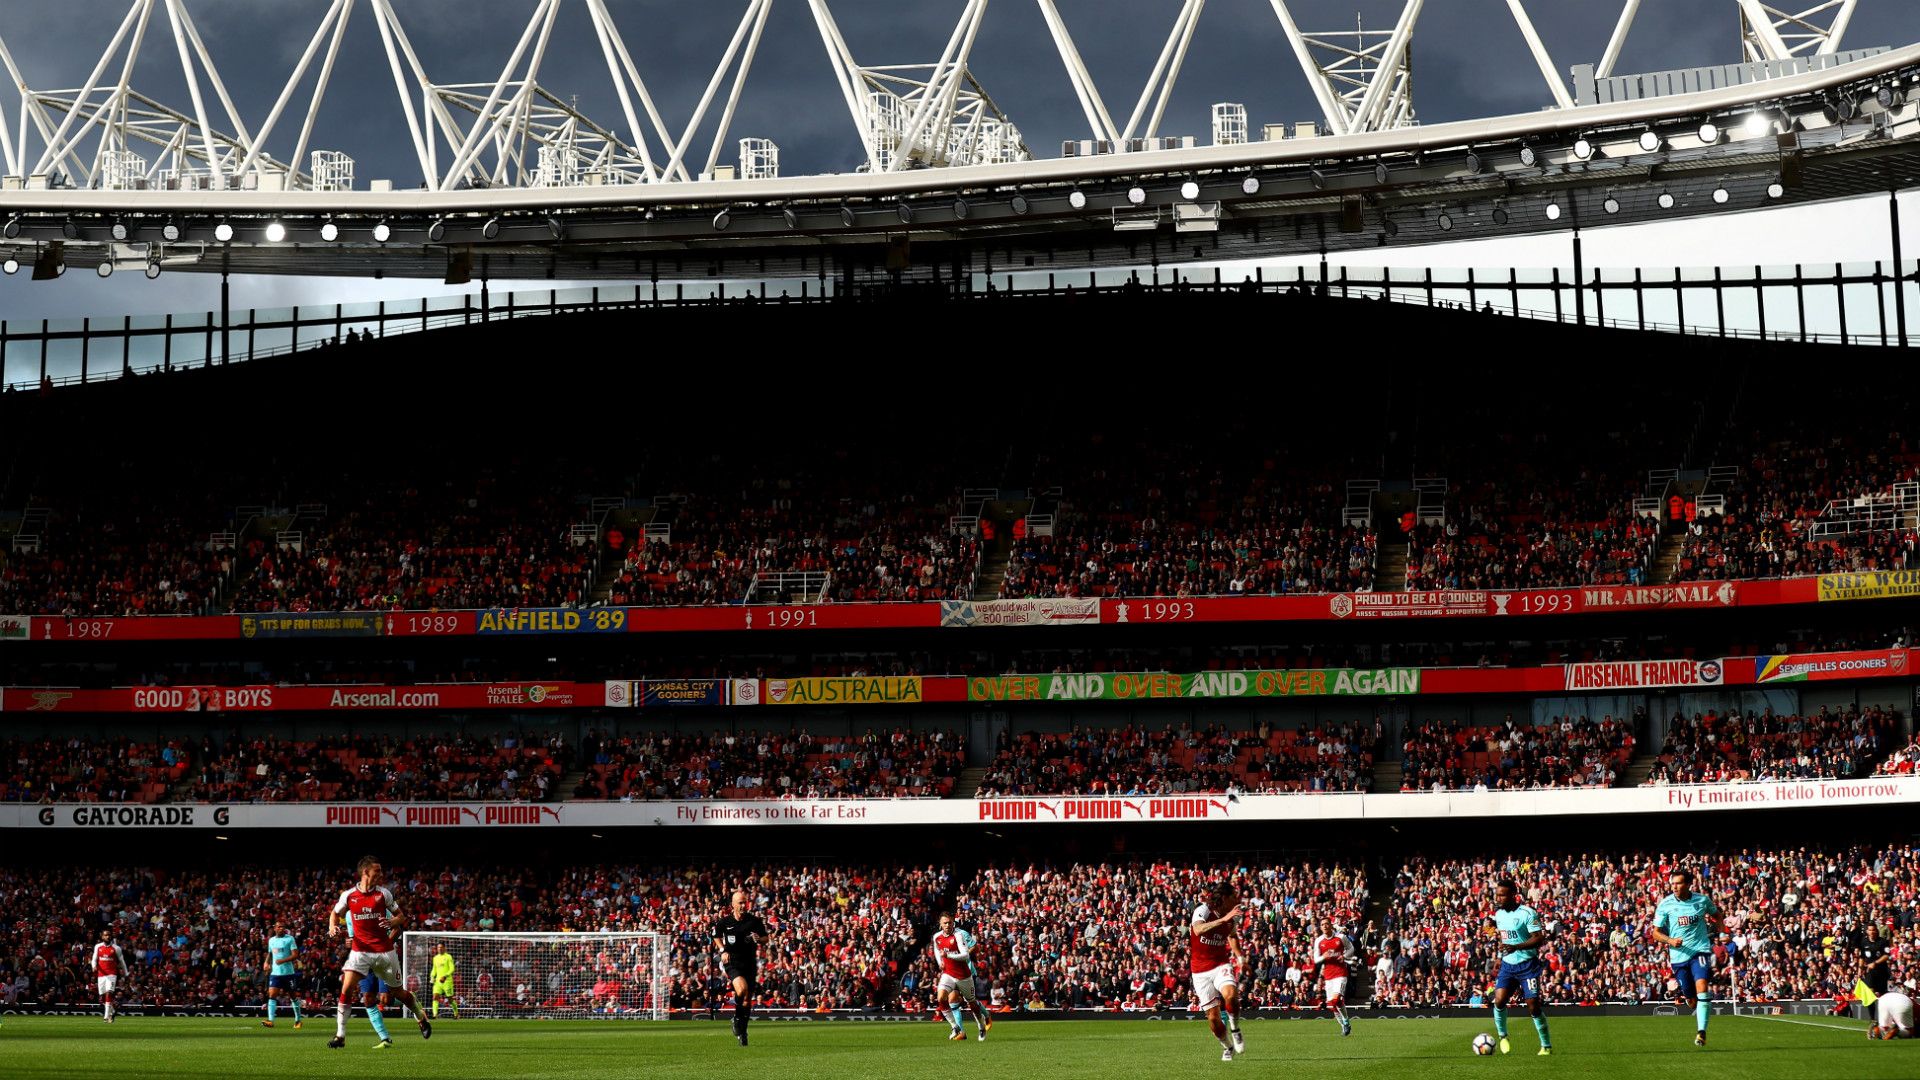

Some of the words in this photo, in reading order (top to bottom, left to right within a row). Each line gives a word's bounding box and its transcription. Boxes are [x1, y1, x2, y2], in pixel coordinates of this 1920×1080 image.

[1355, 593, 1391, 605] PROUD
[1395, 593, 1409, 605] TO
[1412, 593, 1426, 604] BE
[1429, 593, 1437, 604] A
[1585, 590, 1620, 606] MR.
[1623, 586, 1714, 605] ARSENAL
[1835, 587, 1883, 599] YELLOW
[975, 604, 987, 613] we
[988, 602, 1015, 612] would
[1016, 601, 1036, 612] walk
[1142, 602, 1194, 620] 1993
[1381, 609, 1408, 617] RUSSIAN
[1446, 607, 1487, 615] SUPPORTERS
[1521, 594, 1573, 612] 1993
[280, 619, 292, 630] UP
[294, 619, 310, 630] FOR
[312, 618, 342, 630] GRABS
[409, 616, 458, 633] 1989
[479, 610, 580, 631] ANFIELD
[588, 609, 625, 630] '89
[767, 610, 818, 627] 1991
[983, 613, 1001, 624] 500
[1003, 612, 1029, 623] miles!
[66, 621, 114, 638] 1987
[1839, 658, 1887, 670] GOONERS
[1574, 663, 1638, 688] ARSENAL
[1642, 661, 1698, 685] FRANCE
[487, 685, 522, 694] Arsenal
[691, 681, 714, 690] CITY
[791, 679, 919, 701] AUSTRALIA
[971, 676, 1040, 700] OVER
[1047, 674, 1104, 699] AND
[1113, 673, 1182, 698] OVER
[1190, 672, 1248, 697] AND
[1256, 671, 1326, 695] OVER
[1333, 669, 1418, 694] AGAIN
[135, 690, 183, 708] GOOD
[225, 689, 272, 707] BOYS
[330, 689, 439, 707] Arsenal.com
[487, 694, 524, 704] TRALEE
[657, 690, 706, 699] GOONERS
[1668, 790, 1693, 808] Fly
[1699, 788, 1769, 804] Emirates.
[1776, 786, 1814, 801] Hello
[1819, 783, 1902, 799] Tomorrow.
[38, 807, 55, 826] G
[73, 807, 193, 825] GATORADE
[213, 807, 229, 825] G
[326, 806, 380, 825] PUMA
[406, 806, 460, 825] PUMA
[485, 806, 540, 824] PUMA
[677, 806, 697, 822] Fly
[703, 806, 760, 819] Emirates
[766, 807, 779, 819] to
[784, 805, 805, 818] the
[811, 805, 833, 818] Far
[838, 805, 866, 818] East
[979, 801, 1037, 820] PUMA
[1064, 800, 1121, 819] PUMA
[1150, 799, 1207, 818] PUMA
[1526, 978, 1538, 990] 18
